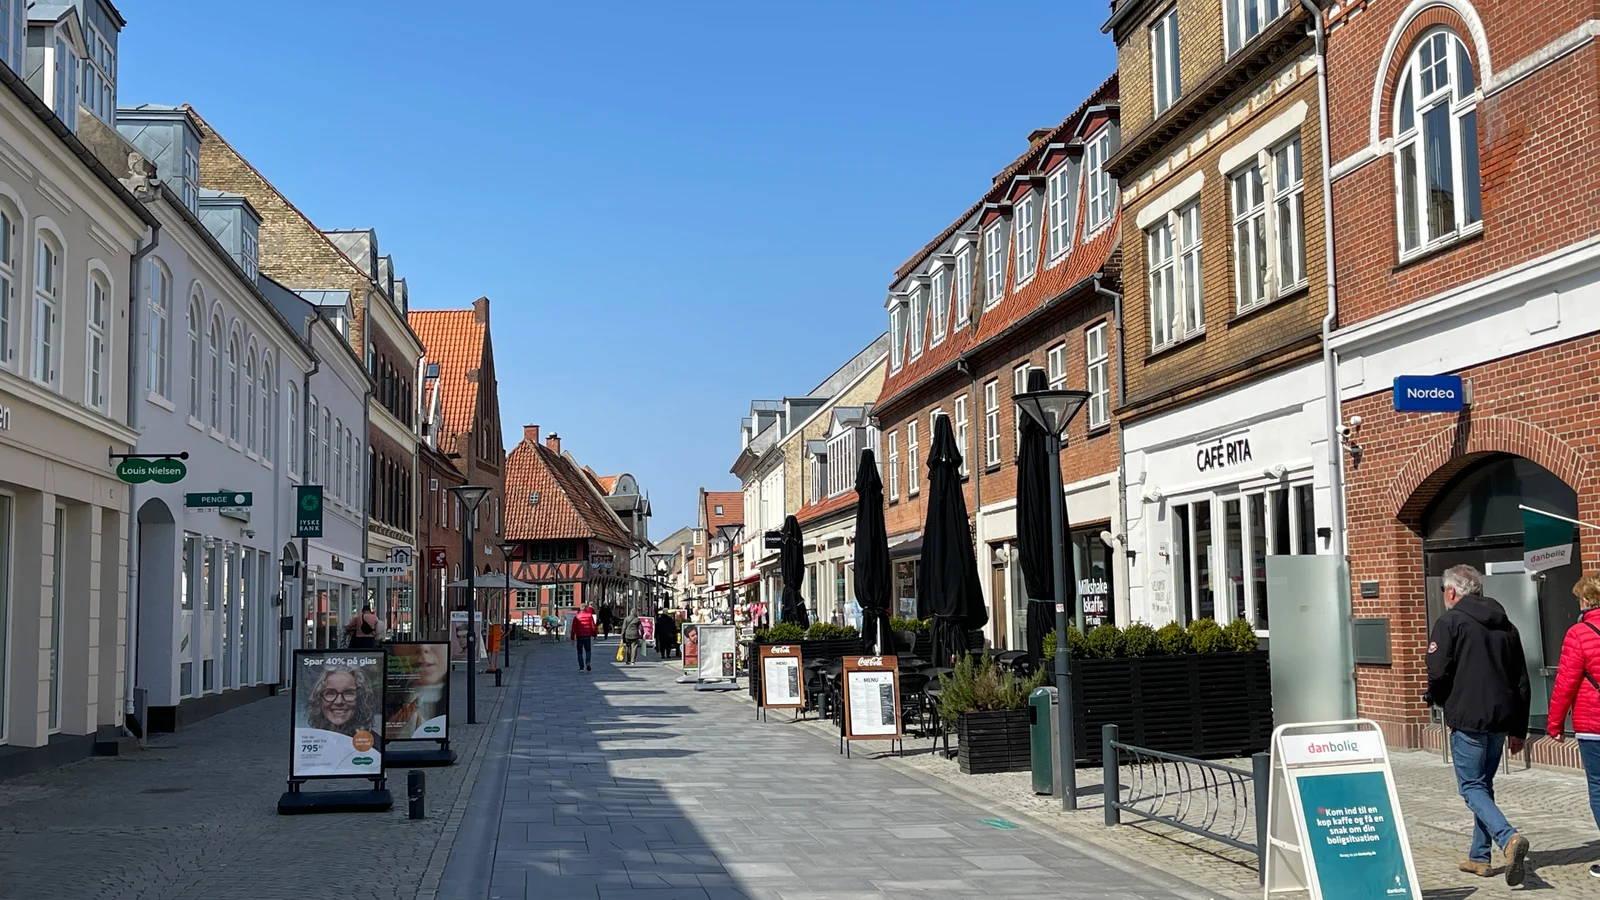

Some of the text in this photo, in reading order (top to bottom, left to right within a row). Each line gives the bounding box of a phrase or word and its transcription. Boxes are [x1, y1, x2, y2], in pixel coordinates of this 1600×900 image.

[1407, 387, 1454, 399] Nordea
[1196, 438, 1252, 472] CAFÉ RITA
[122, 467, 181, 475] Louis Nielsen
[1530, 550, 1566, 562] danbolig
[376, 565, 389, 574] nyt
[1078, 577, 1108, 595] Milkshake
[1082, 595, 1104, 613] Iskaffe
[303, 658, 324, 667] Spar
[325, 657, 346, 666] 40%
[346, 656, 358, 667] på
[359, 656, 377, 667] glas
[301, 744, 319, 753] 795
[1308, 740, 1359, 753] danbolig
[1344, 807, 1357, 815] ind
[1357, 805, 1367, 814] til
[1367, 806, 1378, 814] en
[1316, 818, 1332, 828] kop
[1332, 816, 1353, 825] kaffe
[1353, 817, 1364, 825] og
[1364, 814, 1373, 823] få
[1329, 826, 1348, 835] snak
[1362, 824, 1376, 832] din
[1326, 834, 1380, 846] boligsituation
